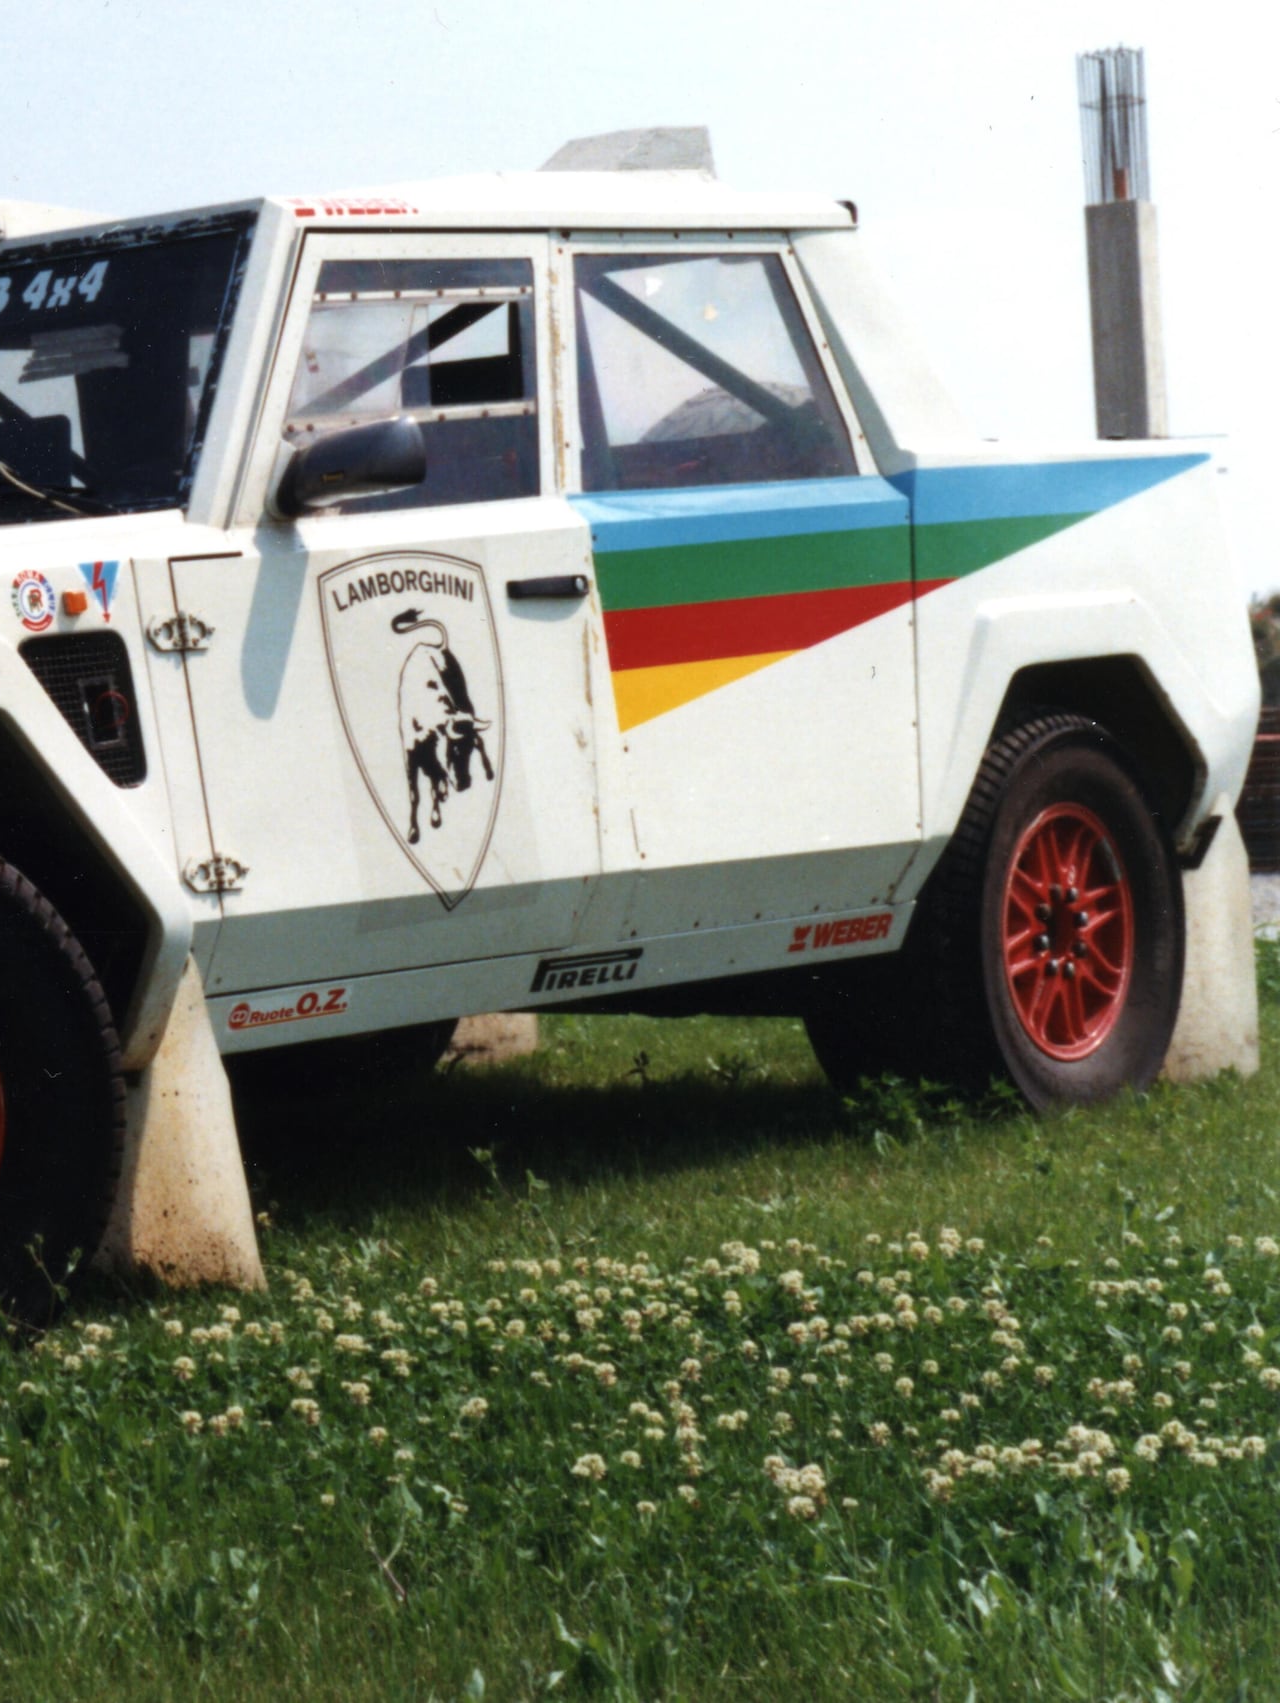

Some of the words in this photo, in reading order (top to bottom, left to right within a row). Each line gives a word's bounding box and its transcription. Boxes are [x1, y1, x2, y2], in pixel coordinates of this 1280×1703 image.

[319, 198, 419, 216] WEBER
[22, 261, 109, 311] 4x4
[331, 569, 474, 612] LAMBORGHINI
[812, 912, 894, 950] WEBER
[529, 947, 644, 993] PIRELLI
[249, 1006, 294, 1024] Ruote
[296, 987, 348, 1016] O.Z.
